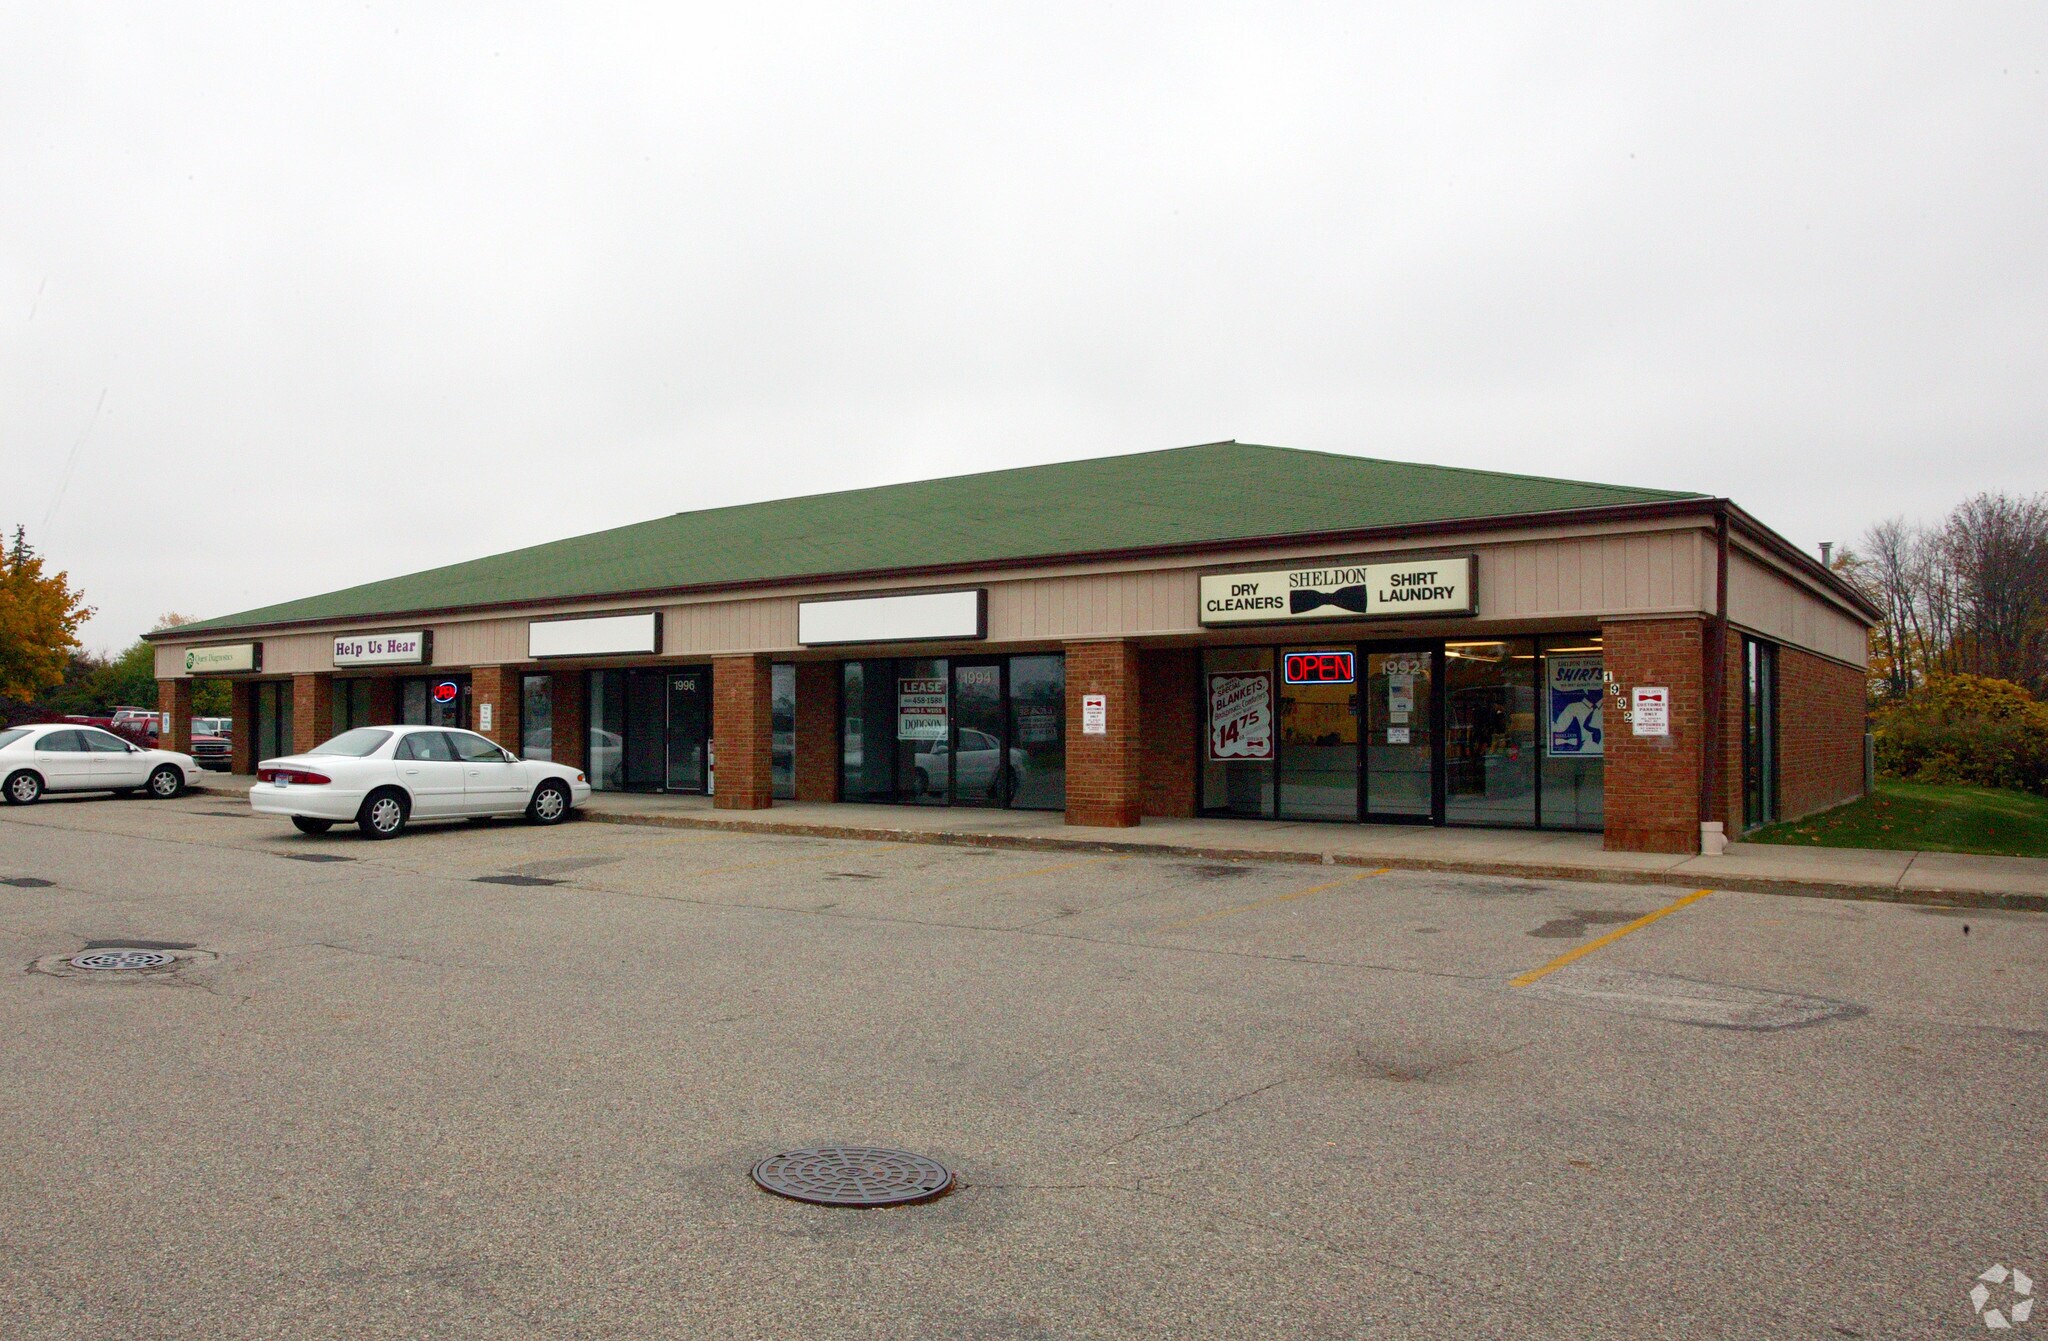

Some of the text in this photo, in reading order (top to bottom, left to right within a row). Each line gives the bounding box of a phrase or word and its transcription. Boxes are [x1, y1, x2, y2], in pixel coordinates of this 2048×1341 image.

[1288, 568, 1367, 588] SHELDON
[1390, 572, 1438, 587] SHIRT
[1231, 583, 1259, 597] DRY
[1379, 586, 1455, 603] LAUNDRY
[1207, 597, 1284, 612] CLEANERS
[336, 639, 416, 657] Help Us Hear
[1287, 655, 1351, 681] OPEN
[1380, 660, 1420, 675] 1992
[1555, 667, 1603, 681] SHIRTS
[962, 671, 992, 684] 1994
[434, 685, 456, 699] OPEN
[673, 680, 695, 691] 1996
[903, 682, 942, 693] LEASE
[905, 719, 942, 730] DODGSON
